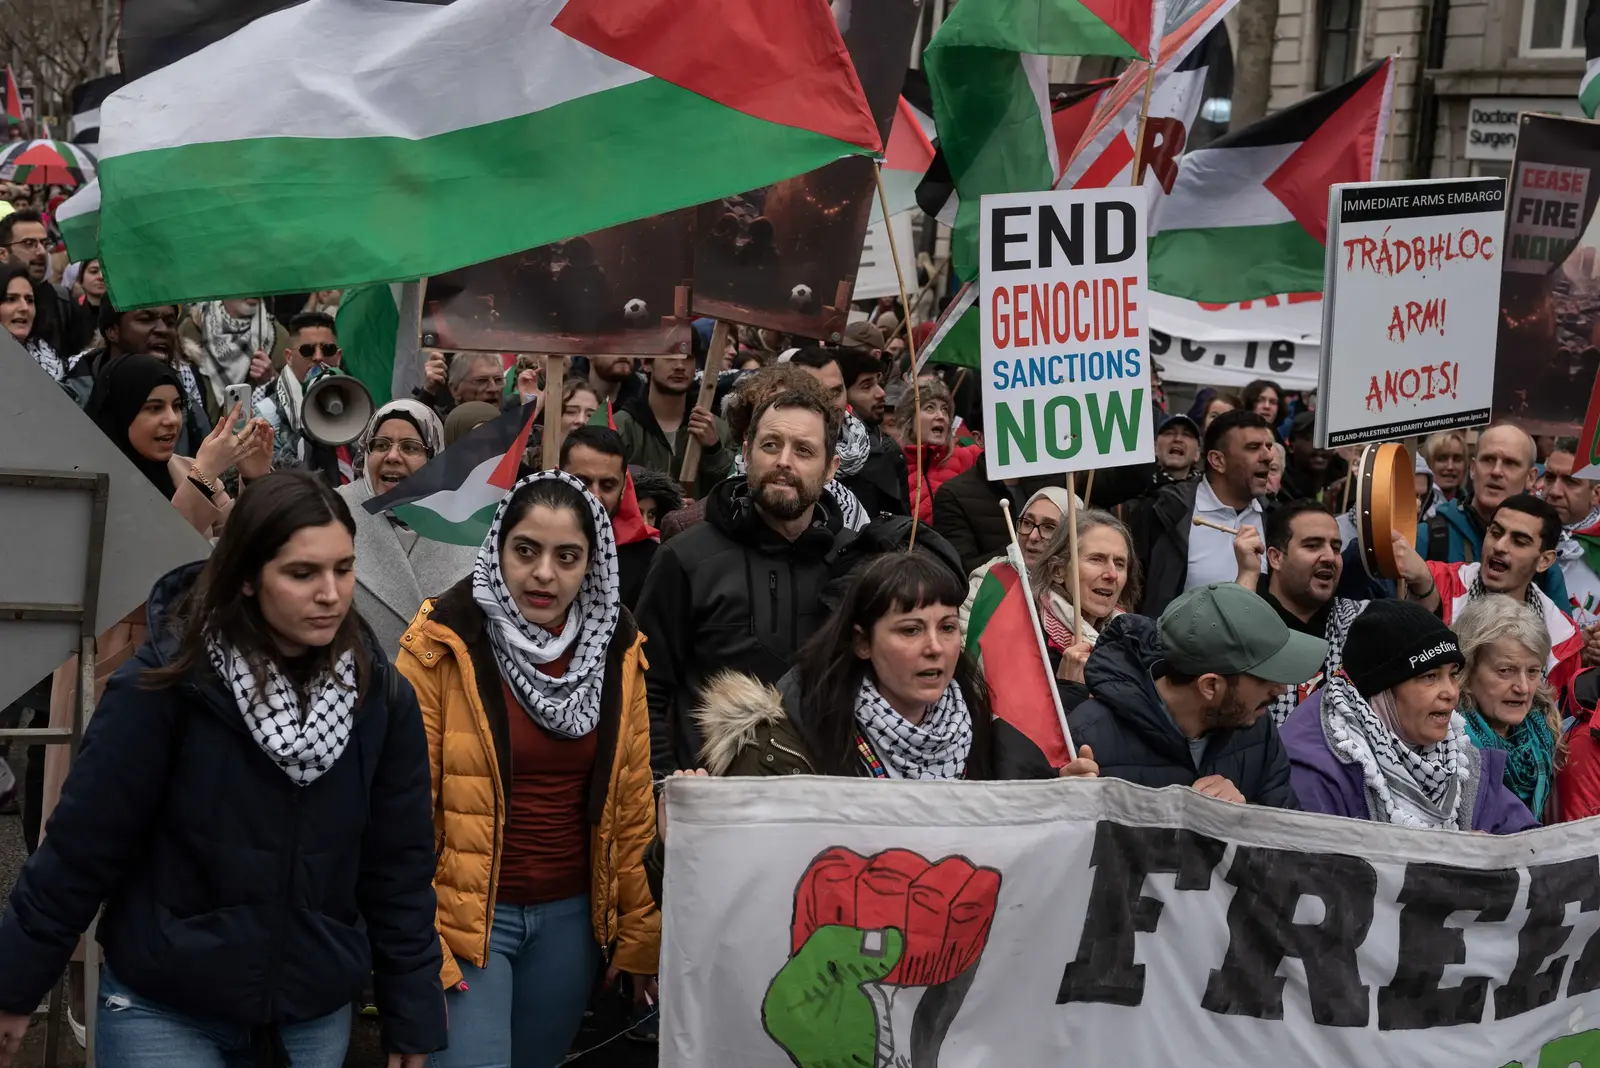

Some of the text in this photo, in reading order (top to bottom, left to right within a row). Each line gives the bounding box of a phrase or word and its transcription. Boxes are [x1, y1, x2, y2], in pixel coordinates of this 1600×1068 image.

[1343, 189, 1502, 212] IMMEDIATE ARMS EMBARGO
[1522, 168, 1584, 194] CEASE
[1516, 197, 1579, 229] FIRE
[991, 200, 1137, 272] END
[1511, 233, 1572, 262] NOW
[992, 276, 1140, 350] GENOCIDE
[1387, 298, 1447, 344] ARM!
[993, 348, 1141, 390] SANCTIONS
[1365, 361, 1459, 413] ANOIS!
[995, 388, 1145, 467] NOW
[1332, 427, 1390, 443] IRELAND-PALESTINE
[1391, 421, 1424, 434] SOLIDARITY
[1424, 416, 1454, 429] CAMPAIGN
[1408, 640, 1457, 669] Palestine
[1055, 819, 1600, 1030] FREE
